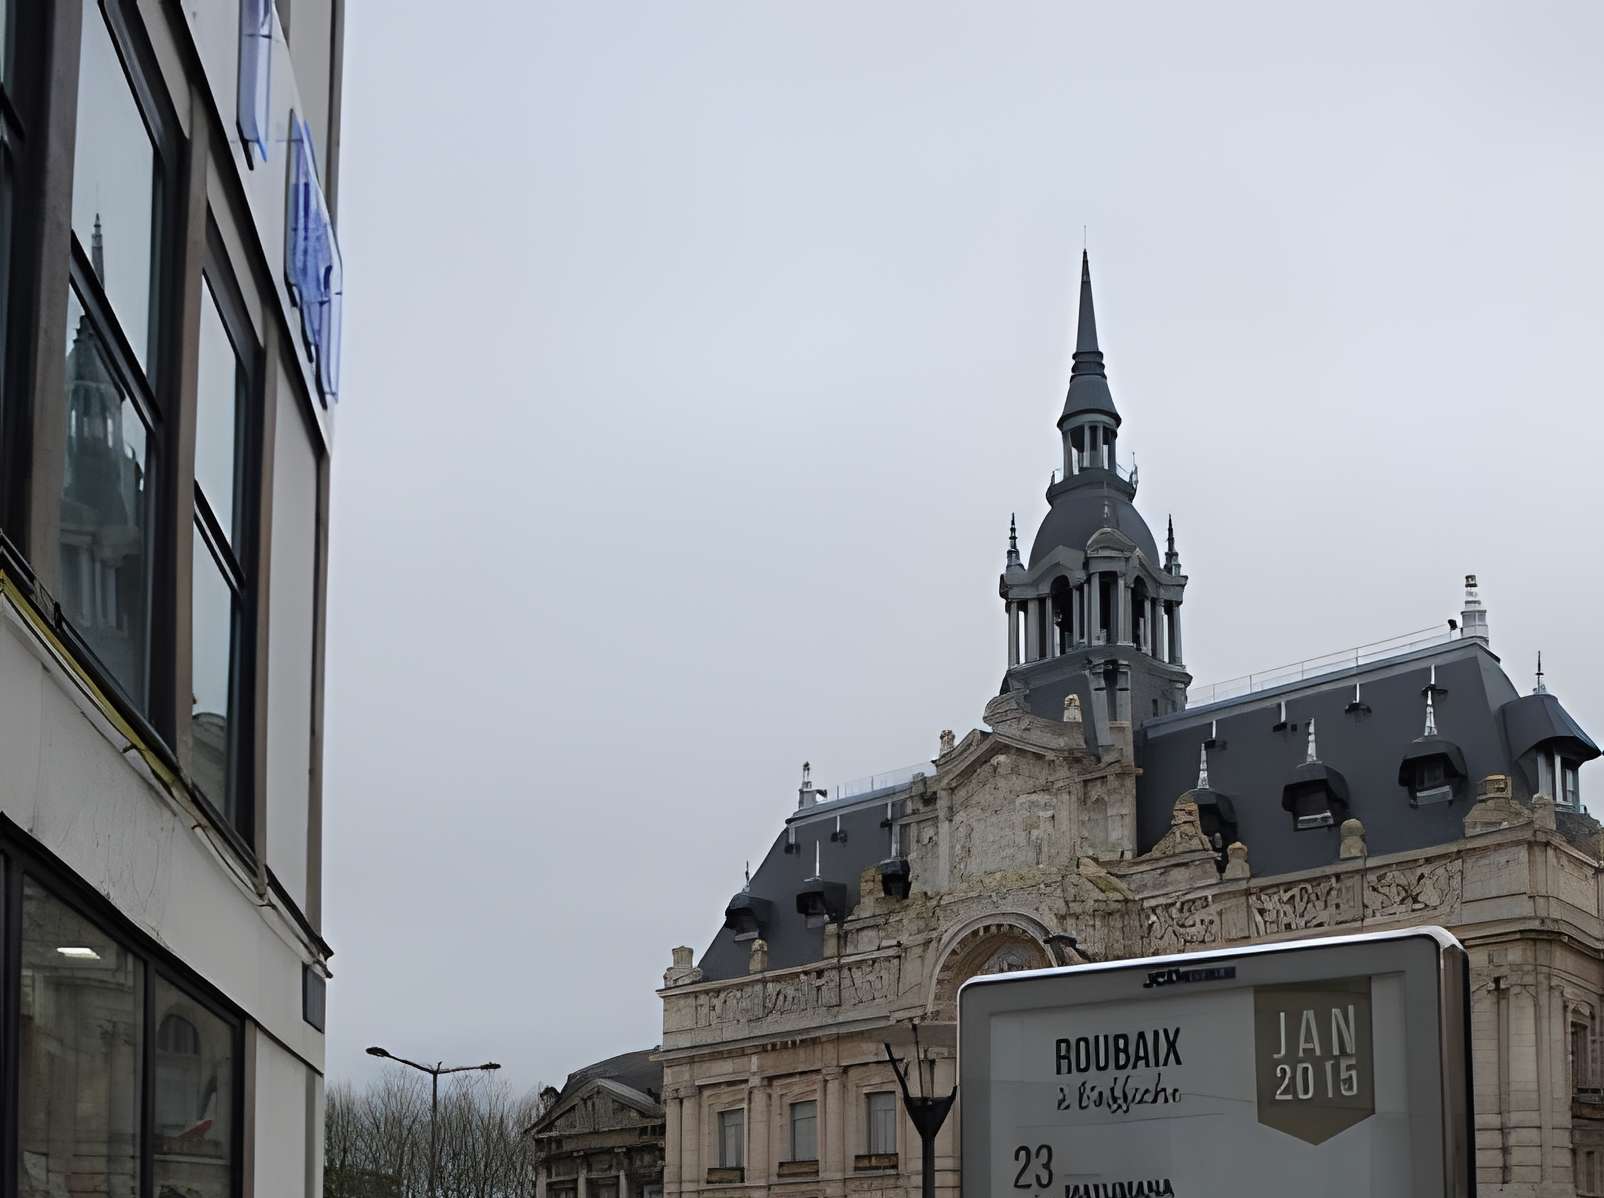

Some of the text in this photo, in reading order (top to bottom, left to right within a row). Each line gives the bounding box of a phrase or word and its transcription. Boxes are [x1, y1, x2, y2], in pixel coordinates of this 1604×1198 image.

[1056, 1026, 1182, 1075] ROUBAIX
[1273, 1004, 1355, 1058] JAN
[1275, 1057, 1357, 1100] 2015
[1014, 1144, 1053, 1189] 23
